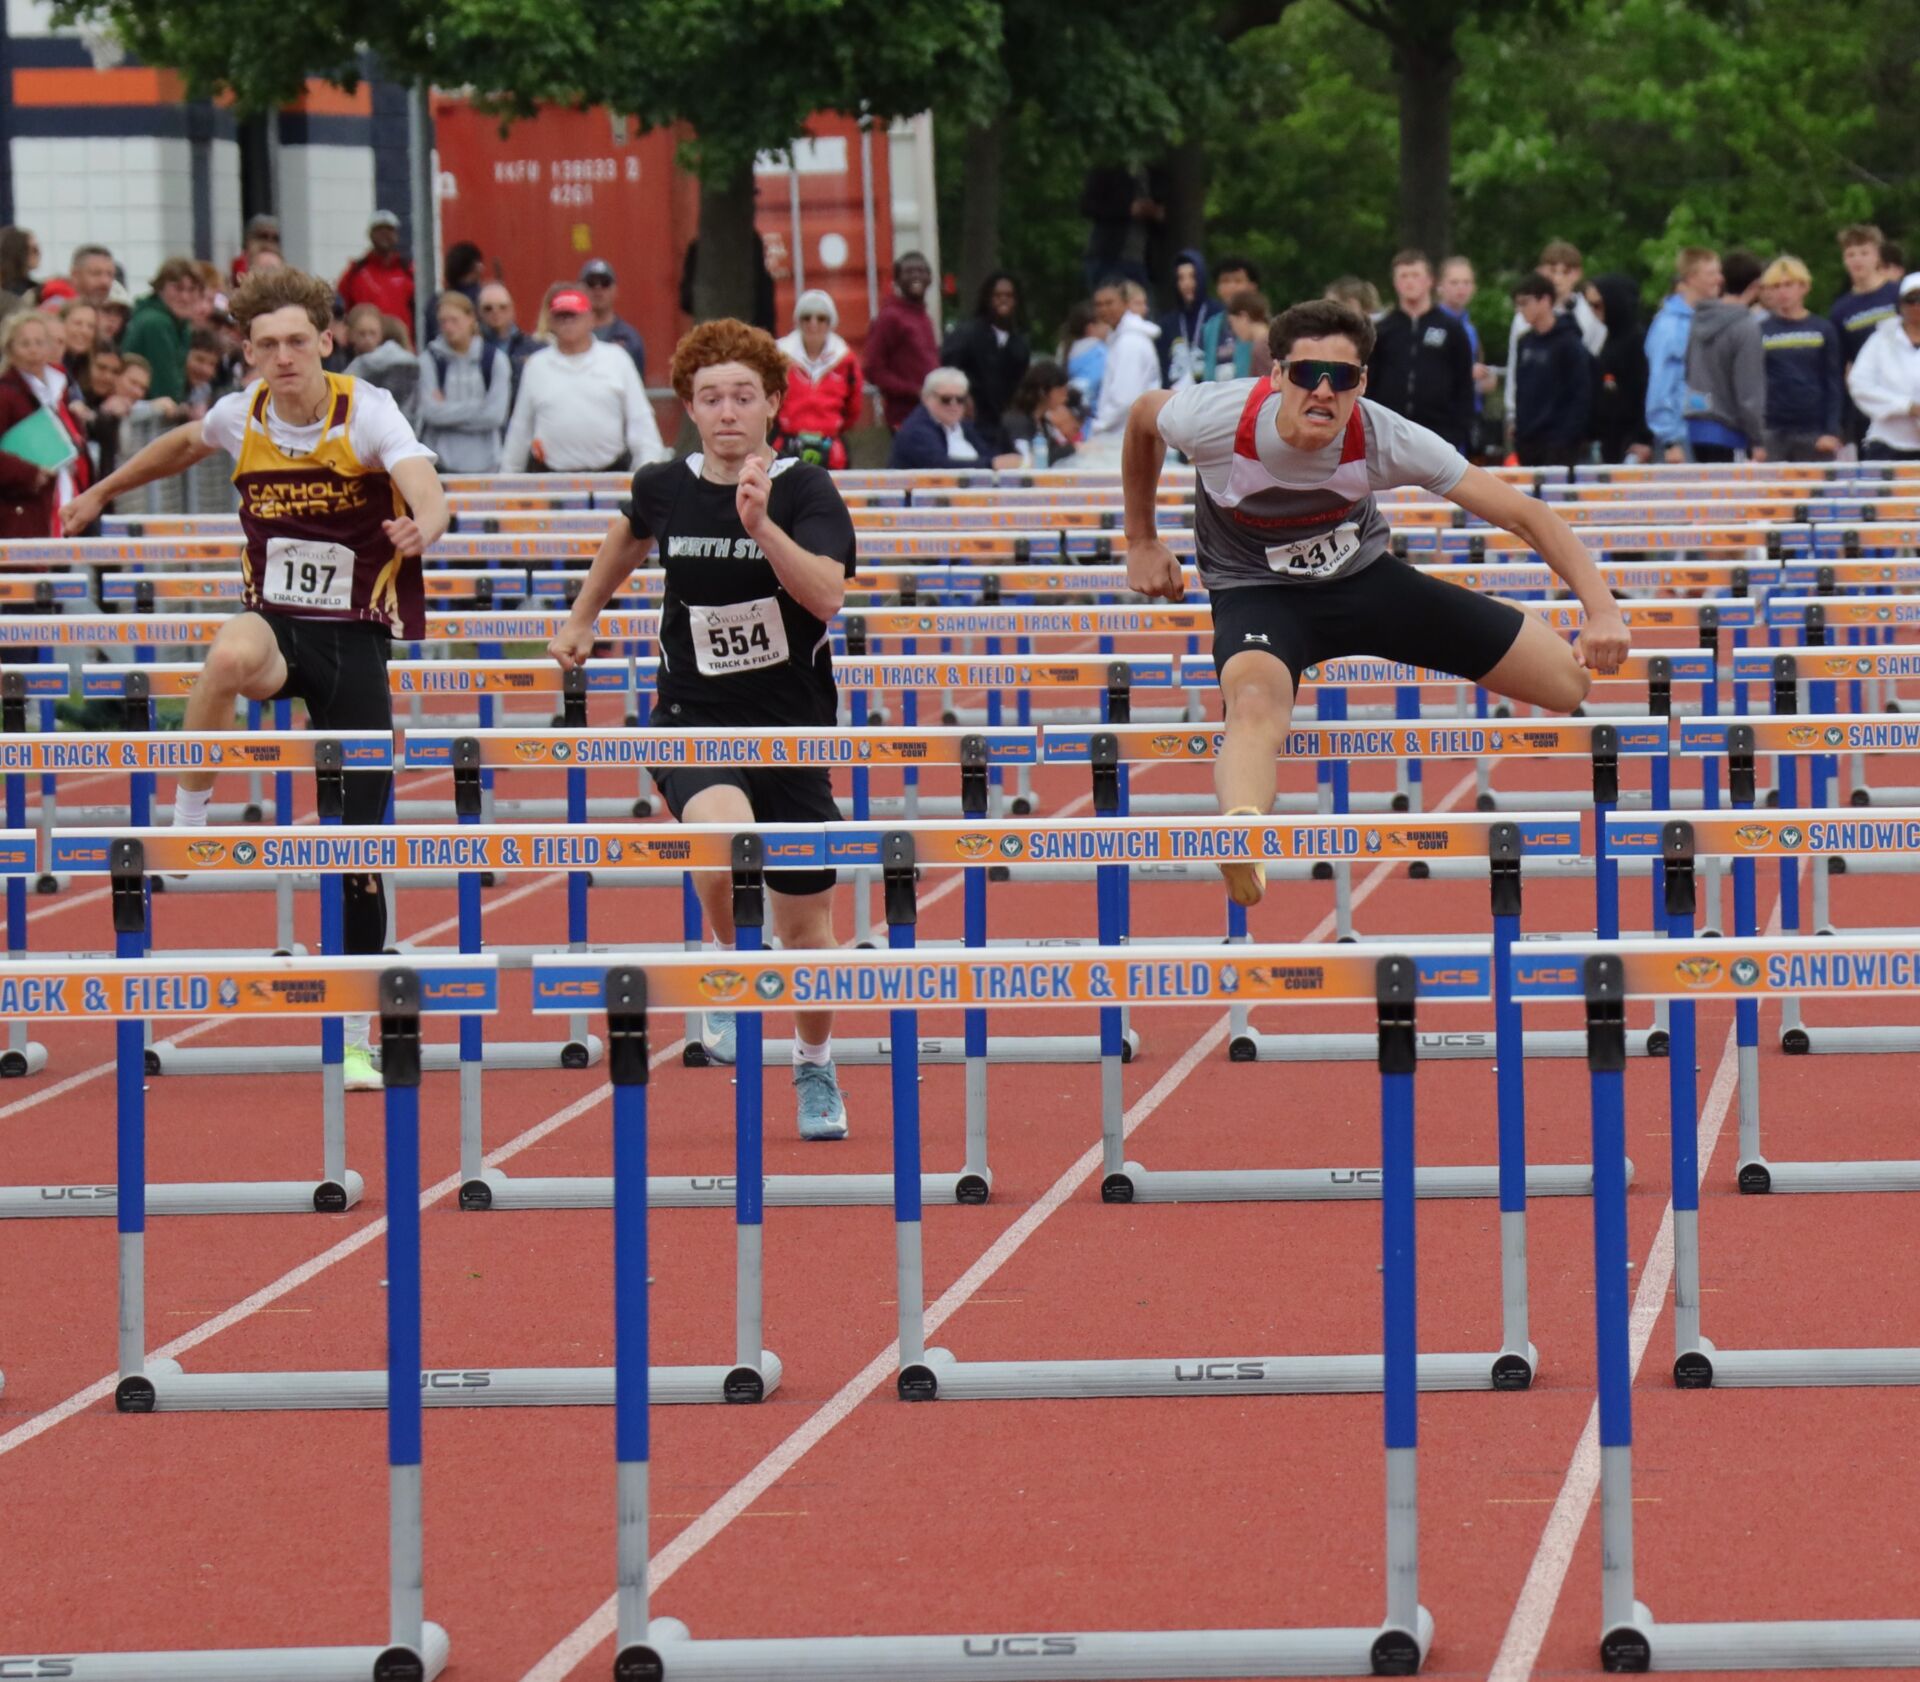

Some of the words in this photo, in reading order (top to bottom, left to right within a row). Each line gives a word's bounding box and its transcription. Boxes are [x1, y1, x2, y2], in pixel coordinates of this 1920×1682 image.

[248, 480, 366, 501] CATHOLIC
[668, 536, 731, 558] NORTH
[733, 538, 768, 559] STA
[283, 560, 337, 594] 197
[273, 592, 303, 604] TRACK
[305, 597, 313, 605] &
[314, 597, 342, 607] FIELD
[936, 614, 1016, 632] SANDWICH
[1023, 614, 1073, 630] TRACK
[1080, 613, 1091, 630] &
[1099, 612, 1140, 629] FIELD
[1559, 609, 1571, 625] &
[69, 625, 118, 641] TRACK
[127, 625, 139, 640] &
[146, 624, 188, 640] FIELD
[463, 619, 544, 636] SANDWICH
[609, 619, 621, 634] &
[629, 618, 659, 634] FIEL
[708, 621, 770, 658] 554
[708, 659, 741, 670] TRACK
[743, 658, 750, 666] &
[752, 651, 780, 665] FIELD
[401, 672, 413, 690] &
[422, 671, 470, 690] FIELD
[881, 665, 936, 684] TRACK
[947, 665, 961, 683] &
[968, 665, 1015, 684] FIELD
[1325, 663, 1415, 682] SANDWICH
[1326, 731, 1399, 755] TRACK
[1405, 731, 1423, 754] &
[1430, 730, 1485, 753] FIELD
[1532, 739, 1560, 748] COUNT
[1620, 733, 1661, 744] UCS
[1684, 733, 1725, 743] UCS
[41, 743, 111, 767] TRACK
[121, 743, 139, 765] &
[146, 742, 204, 765] FIELD
[344, 747, 385, 758] UCS
[409, 747, 450, 758] UCS
[575, 740, 686, 763] SANDWICH
[693, 739, 762, 762] TRACK
[772, 739, 788, 761] &
[797, 739, 854, 761] FIELD
[900, 749, 928, 758] COUNT
[989, 744, 1031, 755] UCS
[1049, 742, 1089, 753] UCS
[253, 753, 281, 762] COUNT
[1028, 830, 1160, 860] SANDWICH
[1169, 829, 1251, 858] TRACK
[1262, 828, 1282, 857] &
[1292, 827, 1359, 856] FIELD
[1406, 830, 1449, 841] RUNNING
[1523, 833, 1571, 846] UCS
[1611, 833, 1659, 846] UCS
[262, 837, 397, 867] SANDWICH
[407, 837, 490, 866] TRACK
[502, 836, 521, 865] &
[532, 835, 600, 865] FIELD
[647, 840, 691, 851] RUNNING
[767, 844, 815, 857] UCS
[830, 842, 878, 855] UCS
[1417, 840, 1449, 850] COUNT
[57, 848, 108, 861] UCS
[658, 850, 691, 860] COUNT
[1271, 966, 1325, 978] RUNNING
[1420, 968, 1480, 985] UCS
[1517, 968, 1578, 984] UCS
[272, 979, 327, 992] RUNNING
[539, 981, 601, 997] UCS
[792, 965, 959, 1002] SANDWICH
[970, 964, 1074, 1000] TRACK
[1089, 964, 1113, 999] &
[1127, 962, 1211, 998] FIELD
[1284, 977, 1325, 989] COUNT
[82, 976, 108, 1013] &
[124, 974, 210, 1012] FIELD
[284, 991, 327, 1004] COUNT
[423, 982, 486, 999] UCS
[1421, 1034, 1486, 1047] UCS
[1330, 1170, 1383, 1184] UC
[1174, 1361, 1266, 1382] UCS
[962, 1636, 1078, 1658] UCS
